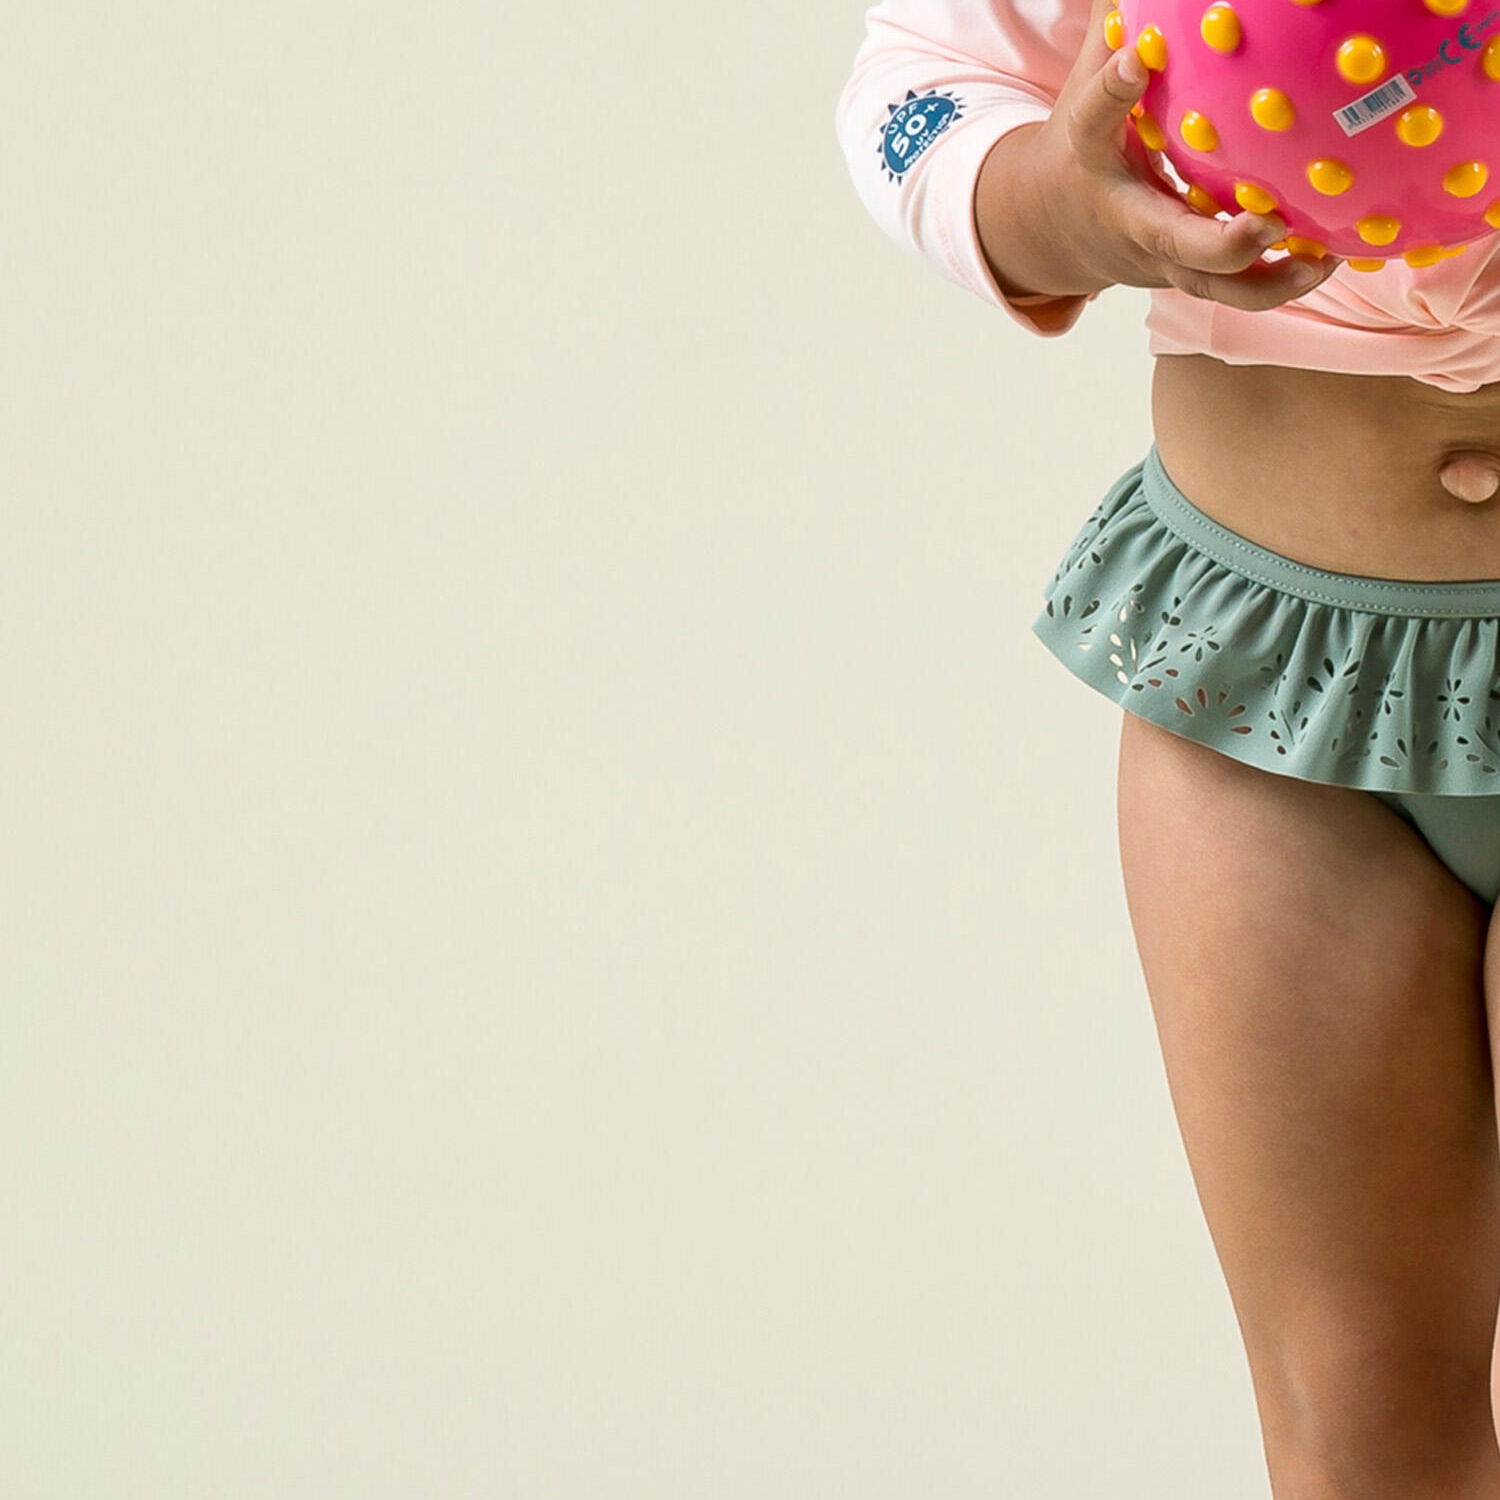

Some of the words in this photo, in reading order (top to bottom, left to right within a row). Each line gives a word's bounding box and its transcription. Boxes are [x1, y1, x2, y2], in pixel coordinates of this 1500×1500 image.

[1439, 23, 1482, 65] CE
[888, 102, 918, 134] UPF
[891, 102, 939, 158] 50+
[915, 128, 929, 146] UV
